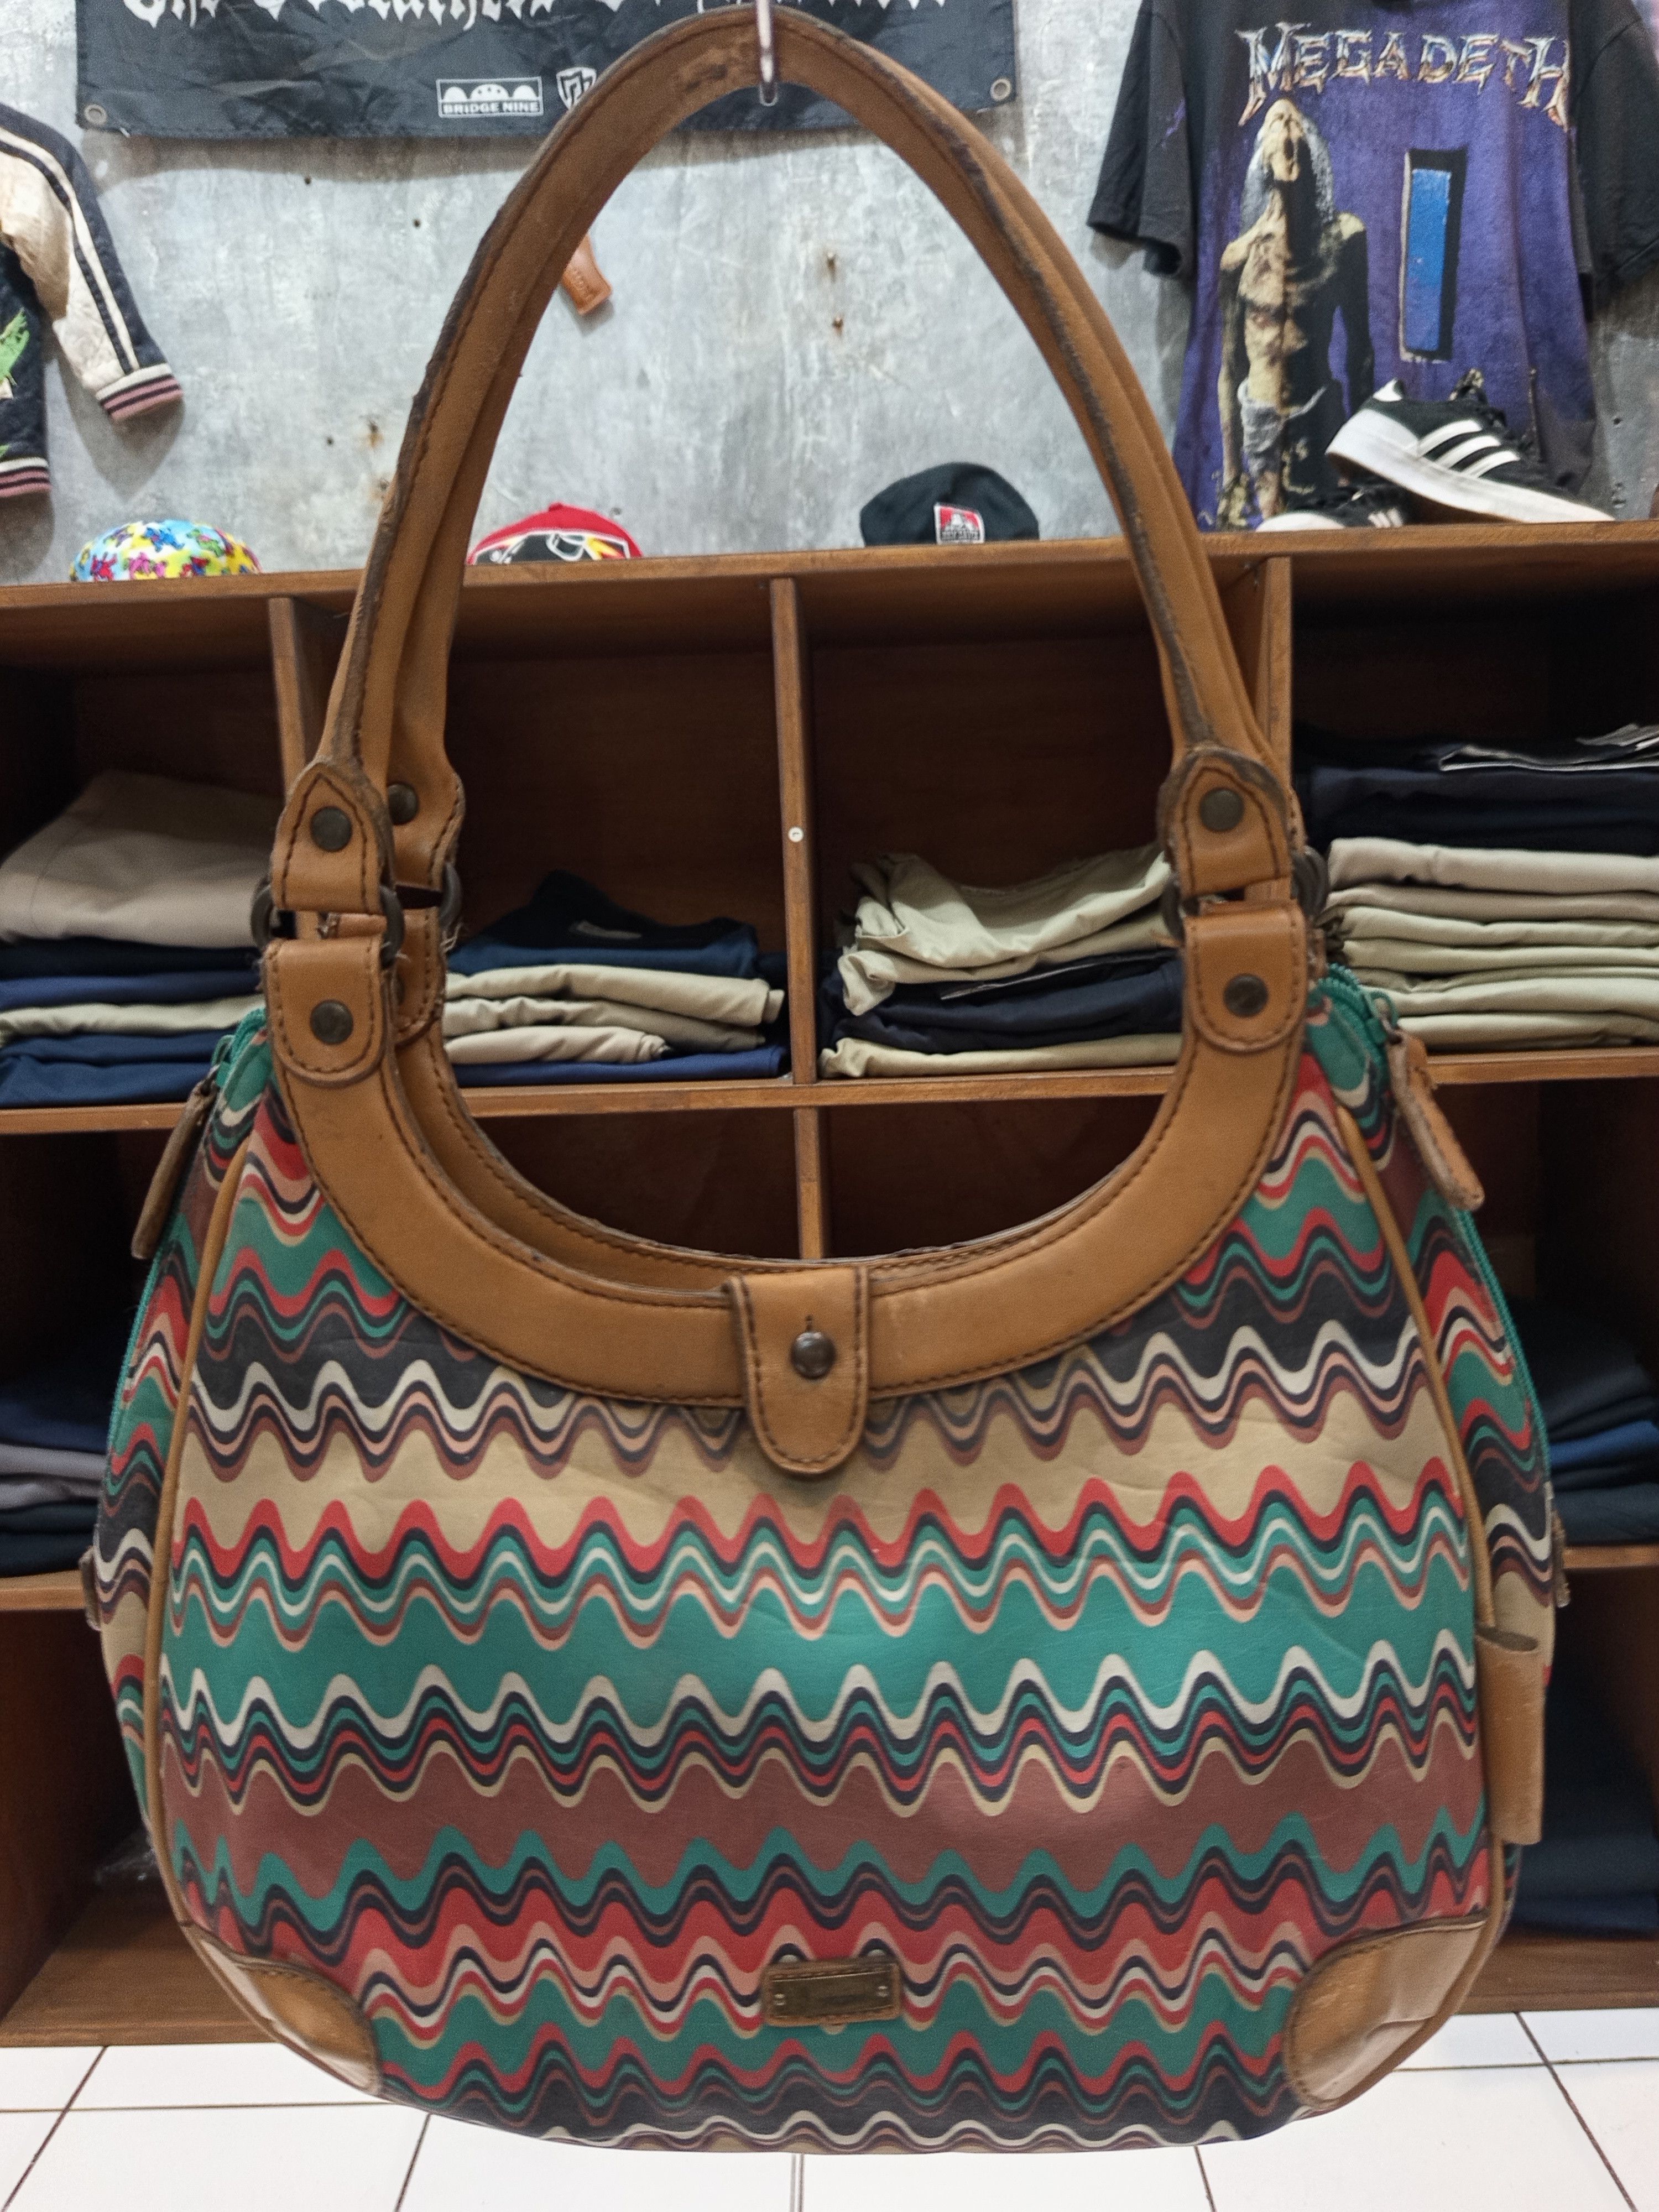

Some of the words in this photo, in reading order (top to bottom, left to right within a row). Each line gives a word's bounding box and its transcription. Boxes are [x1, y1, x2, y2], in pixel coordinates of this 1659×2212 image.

[1235, 22, 1571, 132] MEGADETH
[444, 102, 499, 114] BRIDGE
[502, 102, 539, 112] NINE
